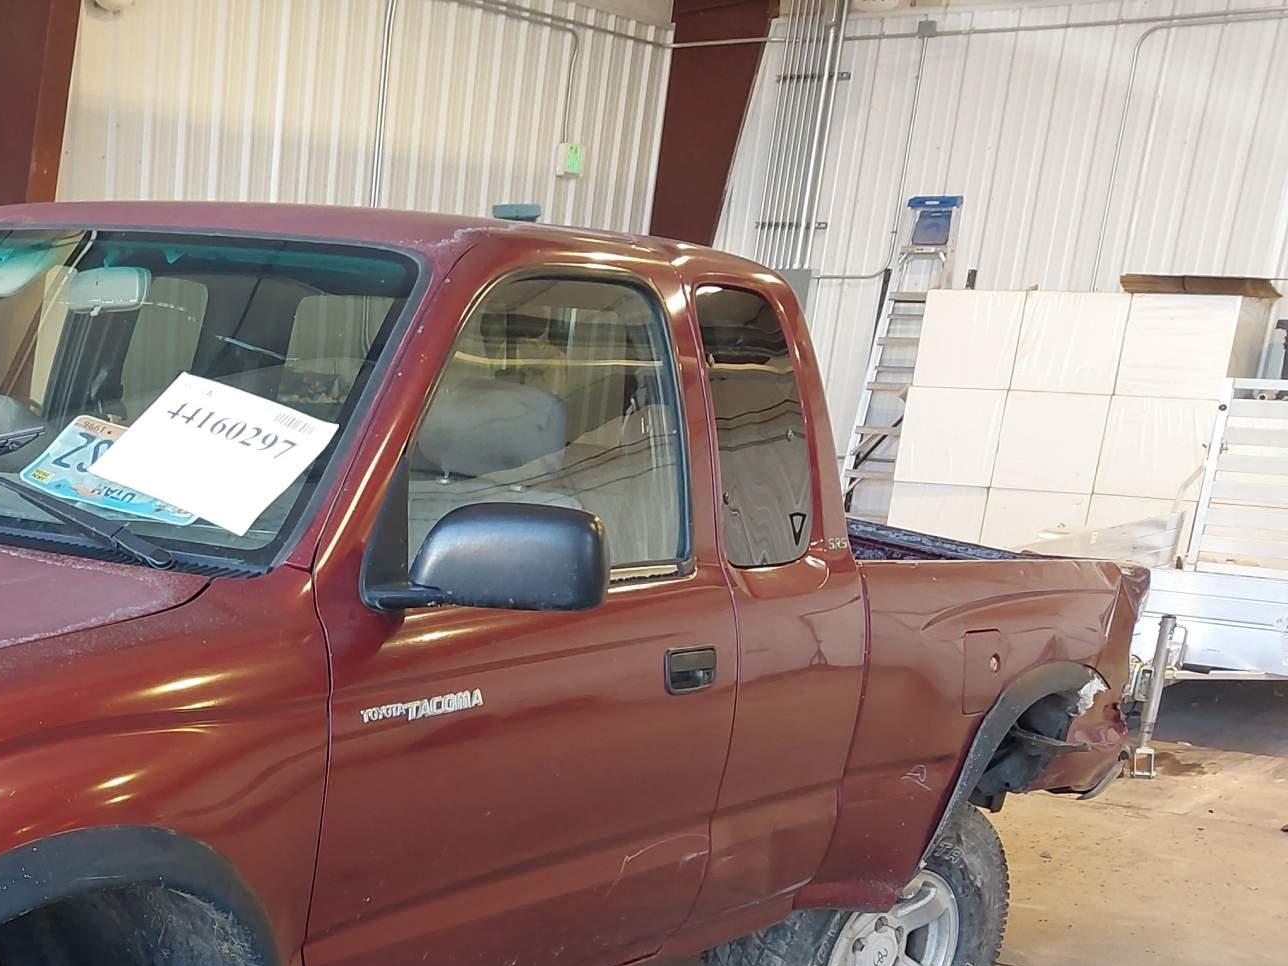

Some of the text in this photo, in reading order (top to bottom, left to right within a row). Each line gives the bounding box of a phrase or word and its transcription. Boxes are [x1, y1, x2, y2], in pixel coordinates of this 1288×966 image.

[166, 402, 298, 459] 44160297
[90, 483, 136, 502] UTAH
[361, 688, 484, 723] TOYOTA TACOMA
